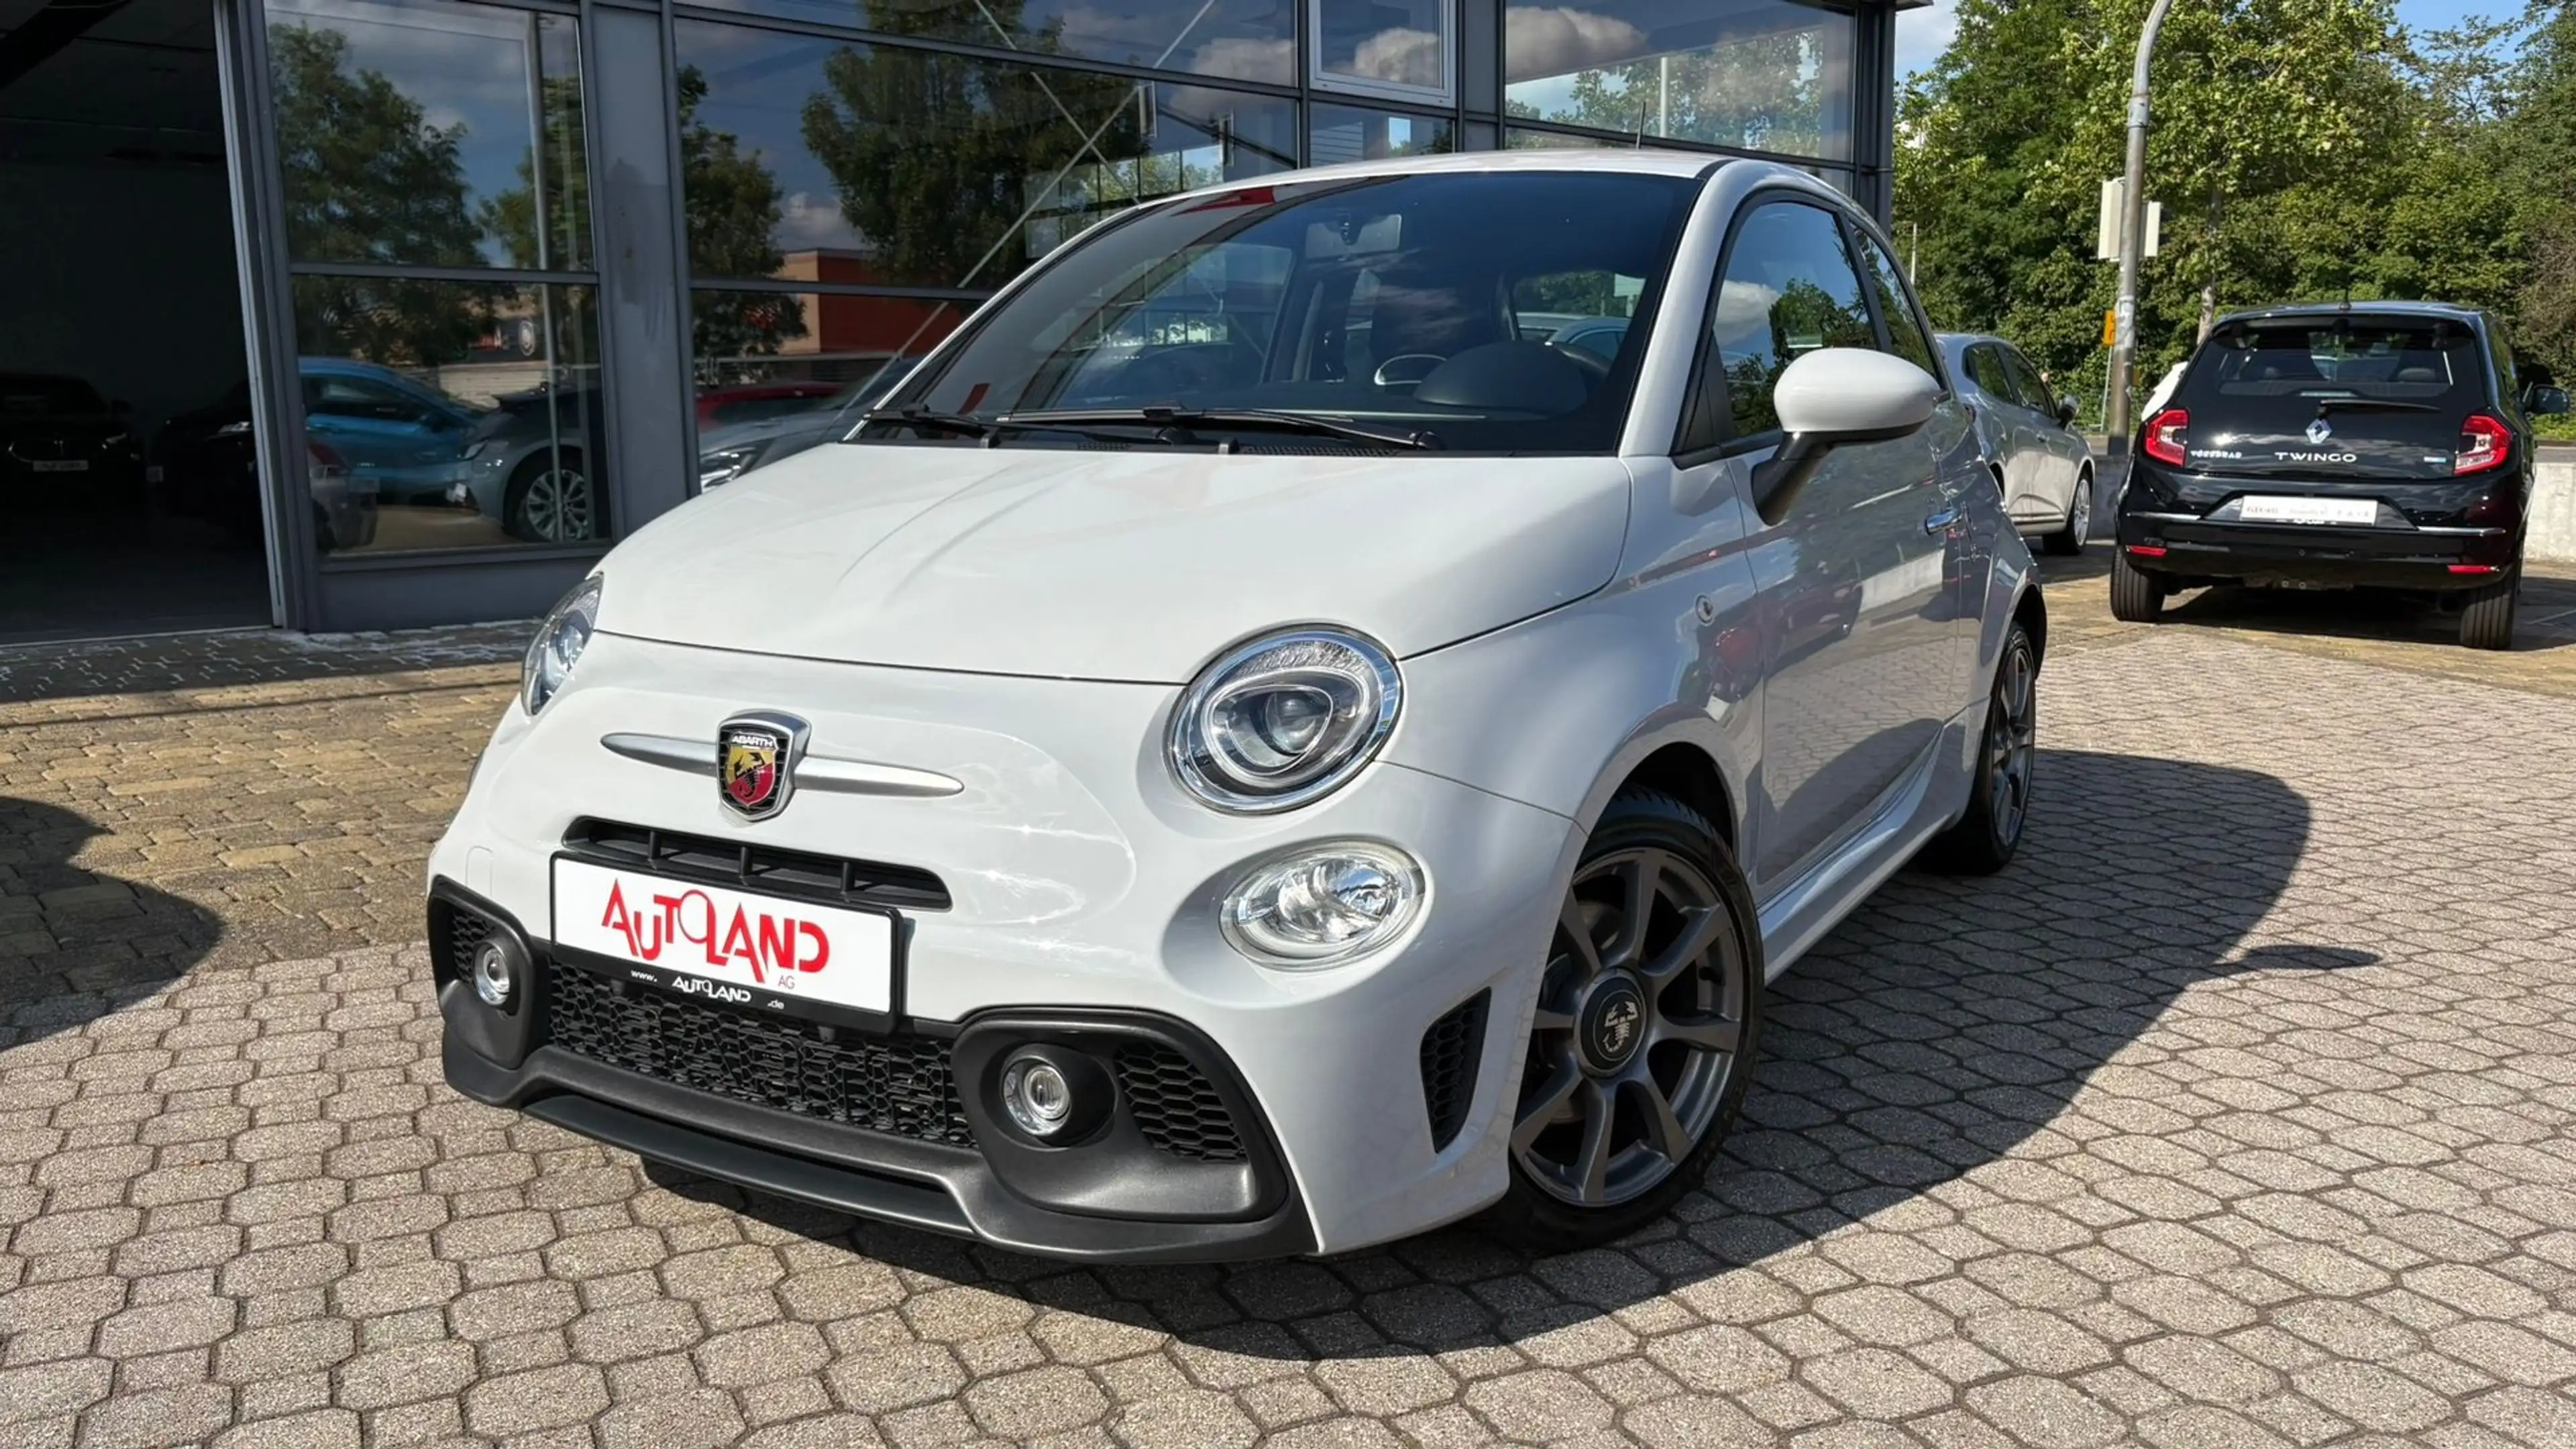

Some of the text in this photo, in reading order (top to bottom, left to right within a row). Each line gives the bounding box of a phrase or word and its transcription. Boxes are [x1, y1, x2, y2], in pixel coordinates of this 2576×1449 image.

[2275, 451, 2357, 463] TWINGO
[731, 735, 773, 747] ABARTH
[602, 878, 830, 984] AUTOLAND
[672, 976, 752, 1002] AUTOLAND
[778, 975, 796, 989] AG
